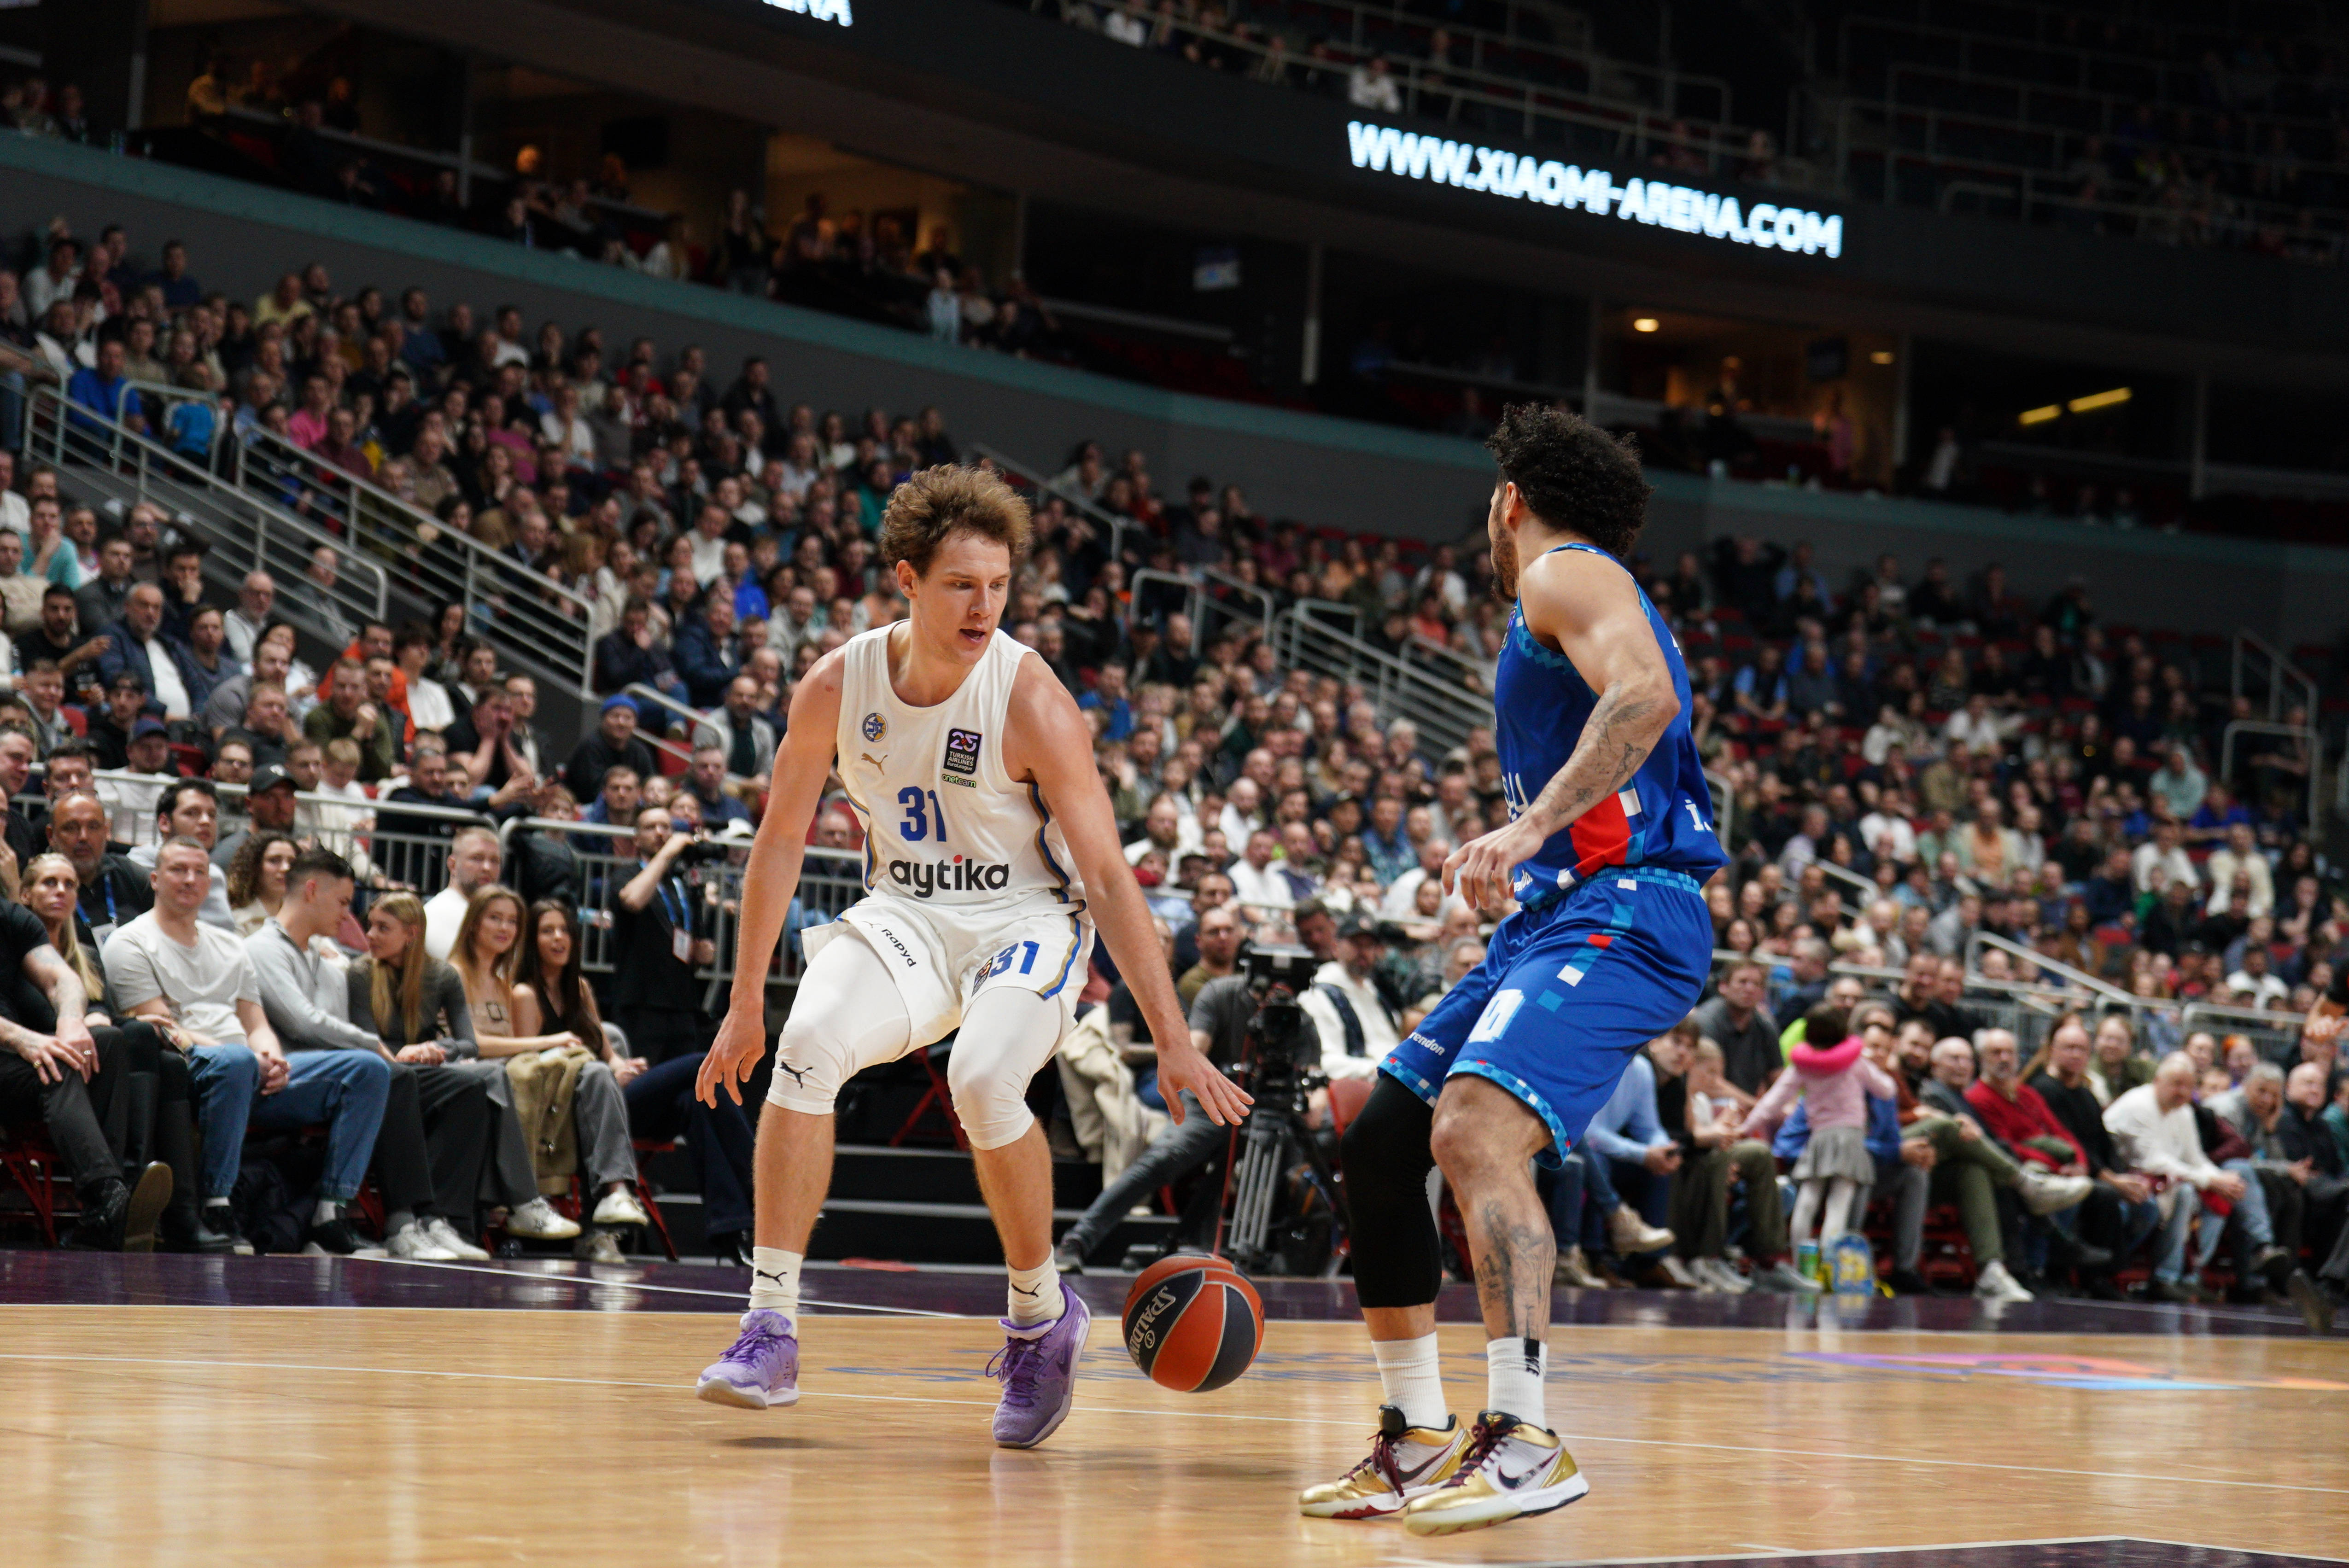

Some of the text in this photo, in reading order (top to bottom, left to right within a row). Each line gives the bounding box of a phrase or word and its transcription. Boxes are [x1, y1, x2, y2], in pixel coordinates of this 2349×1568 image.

[1348, 121, 1842, 259] WWW.XIAOMI-ARENA.COM
[949, 751, 974, 761] TURKISH
[950, 731, 978, 752] 25
[948, 756, 973, 766] AIRLINES
[897, 786, 947, 842] 31
[889, 854, 1009, 898] aytika
[881, 929, 917, 968] Rapyd
[988, 940, 1040, 978] 31
[1407, 1032, 1445, 1056] rendon
